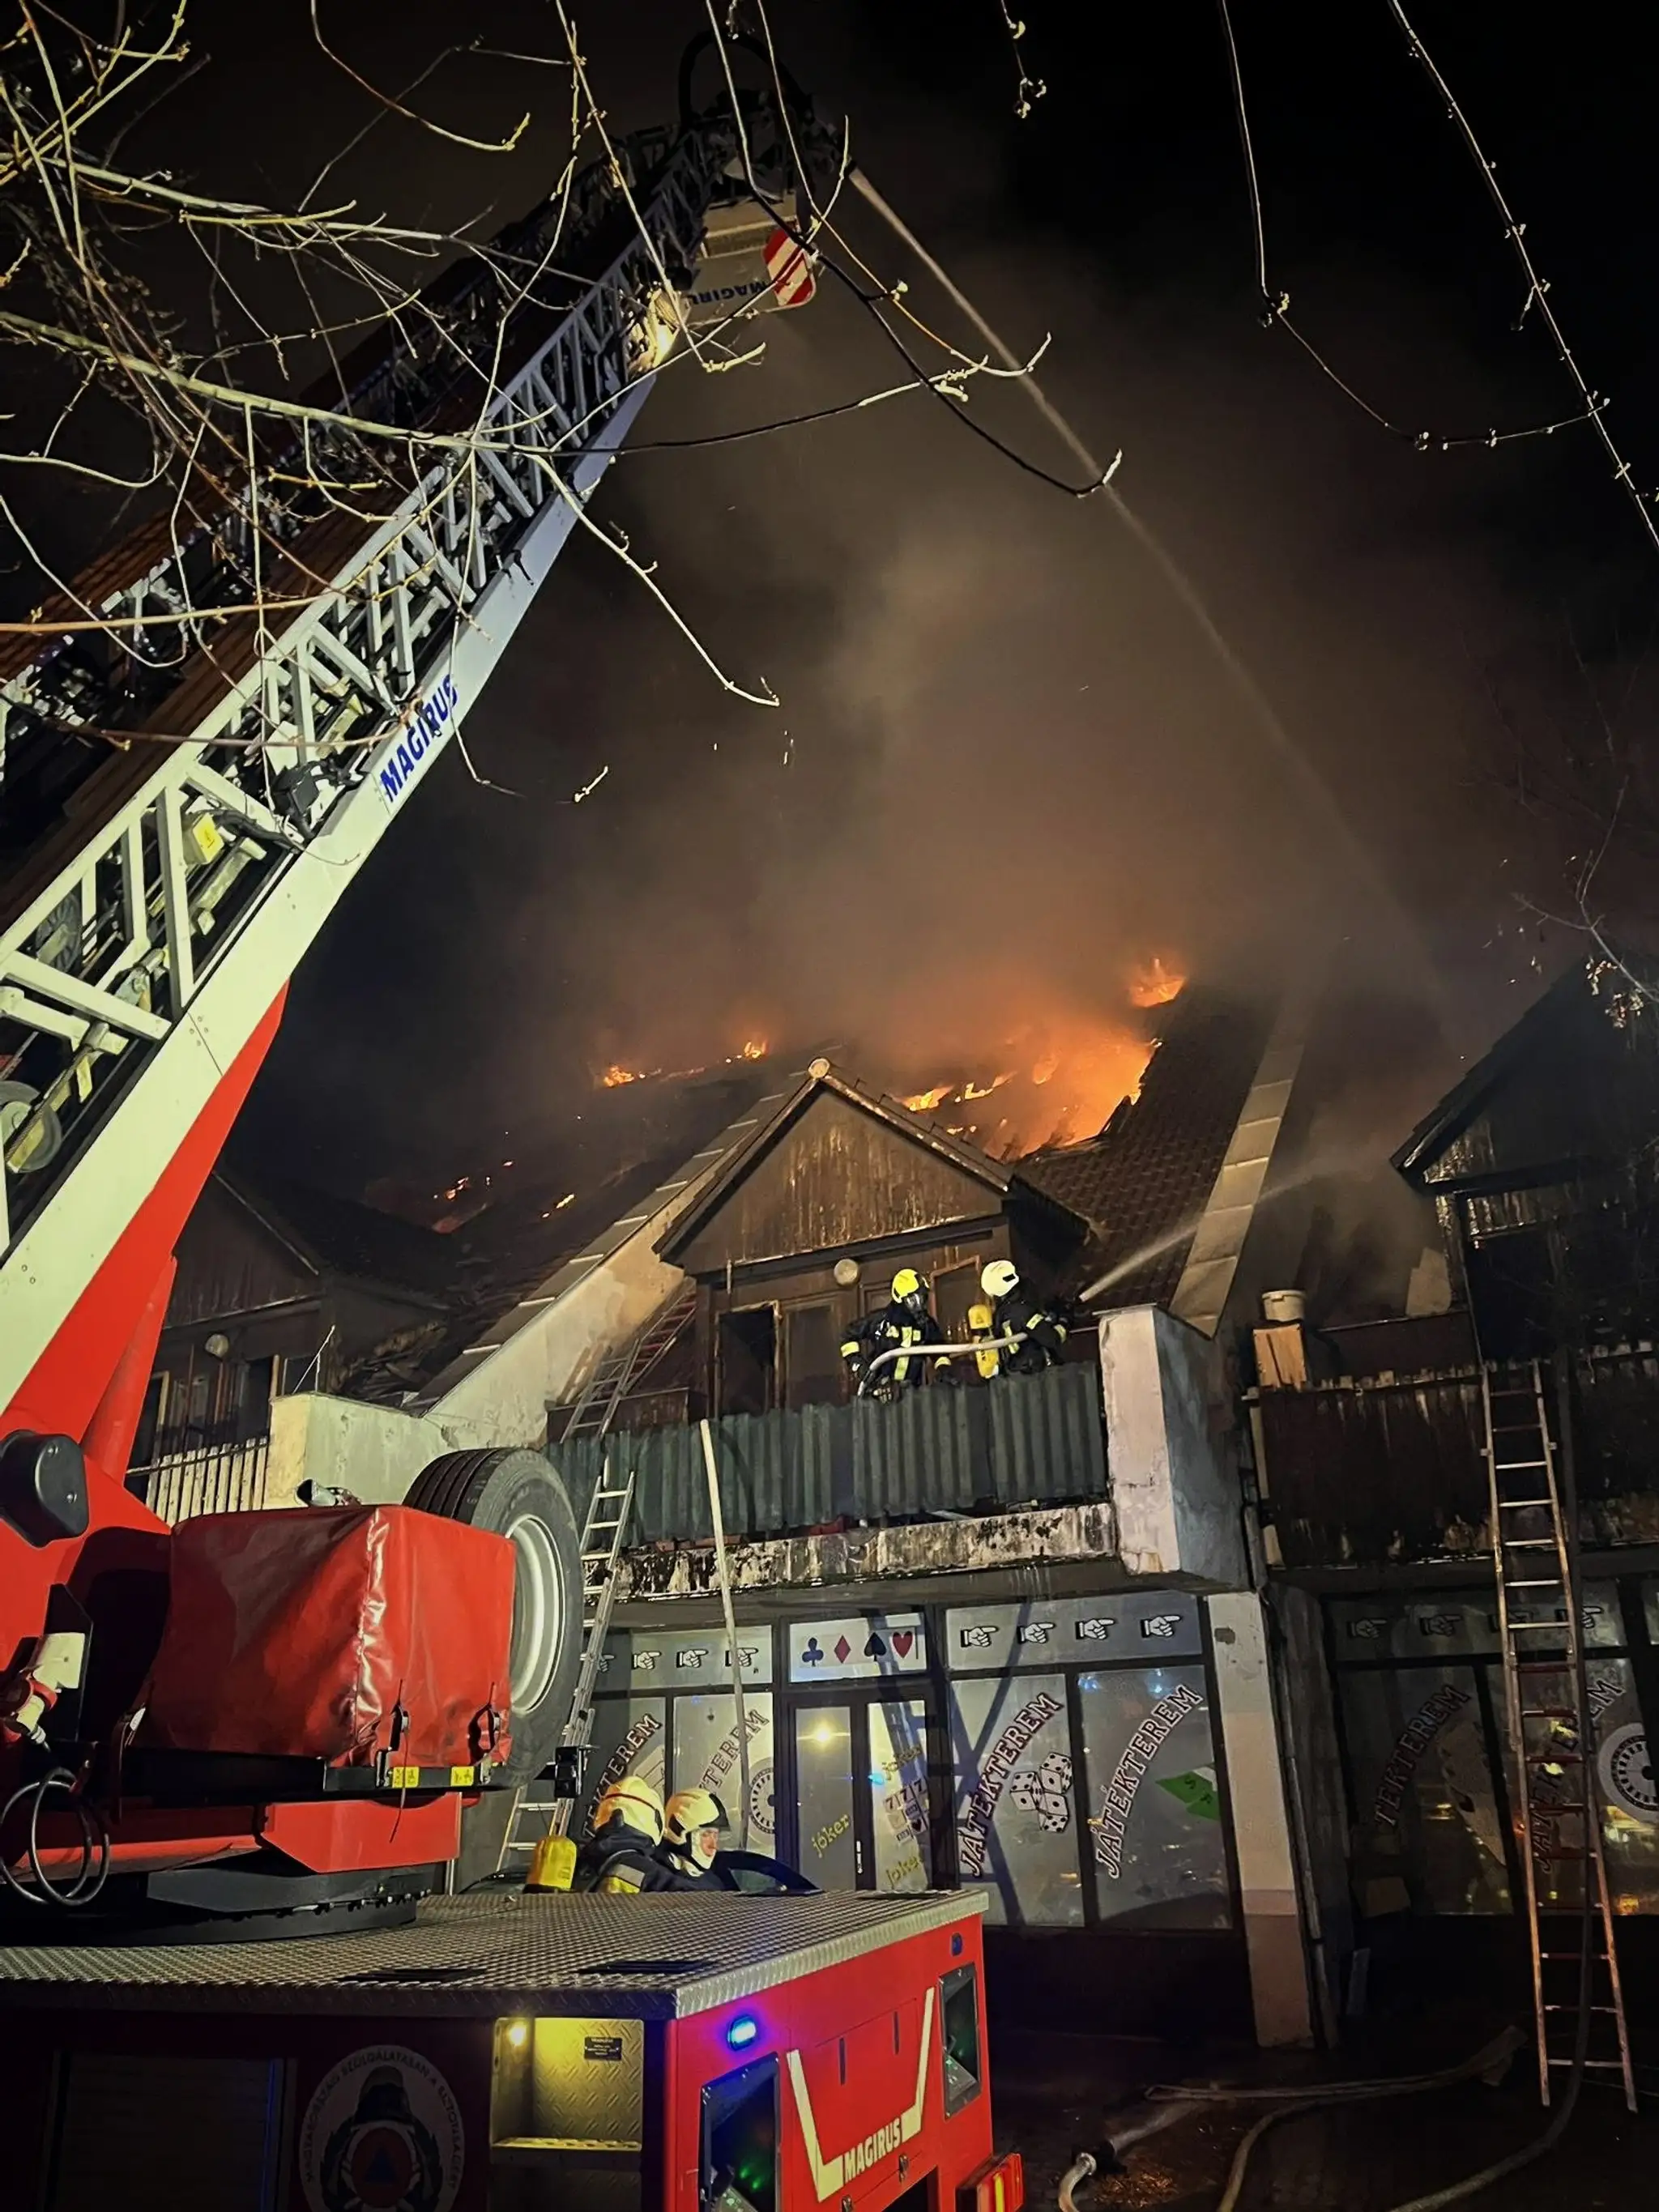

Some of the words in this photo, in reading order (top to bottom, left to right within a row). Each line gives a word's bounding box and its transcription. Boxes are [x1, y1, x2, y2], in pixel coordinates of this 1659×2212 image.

[380, 674, 458, 803] MAGIRUS
[811, 1813, 850, 1859] joker
[843, 2116, 902, 2184] MAGIRUS
